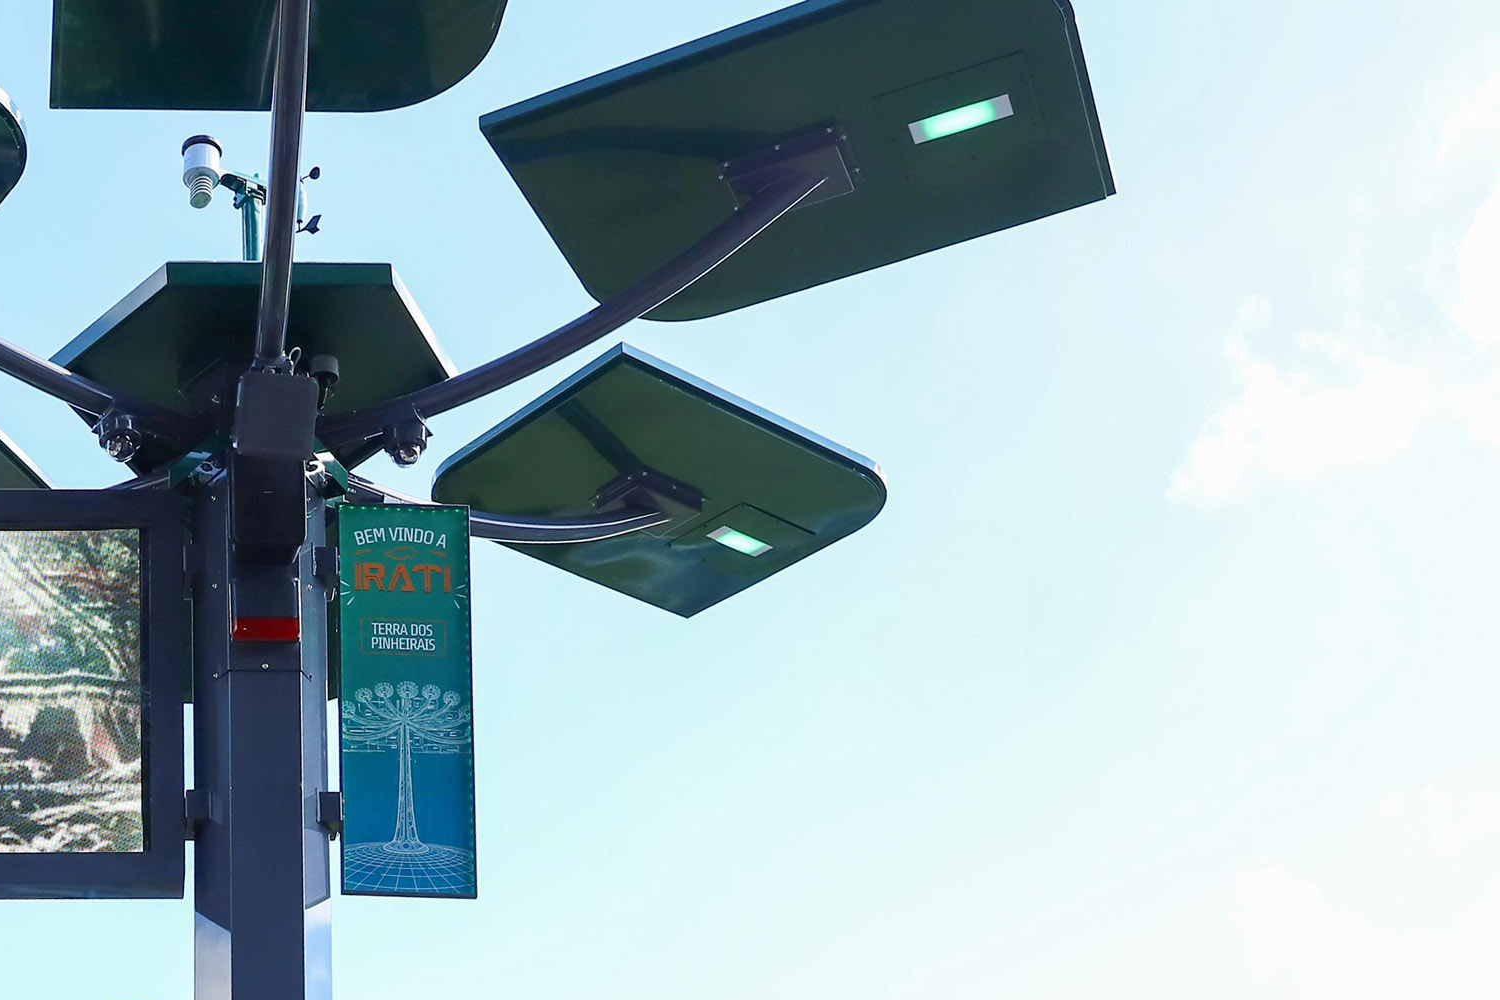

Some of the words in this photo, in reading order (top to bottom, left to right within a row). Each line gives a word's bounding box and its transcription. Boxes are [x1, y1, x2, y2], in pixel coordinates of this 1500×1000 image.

[354, 528, 386, 546] BEM
[388, 527, 434, 545] VINDO
[435, 533, 447, 549] A
[354, 562, 451, 593] IRATI
[371, 622, 408, 636] TERRA
[411, 624, 433, 637] DOS
[371, 637, 436, 651] PINHEIRAIS
